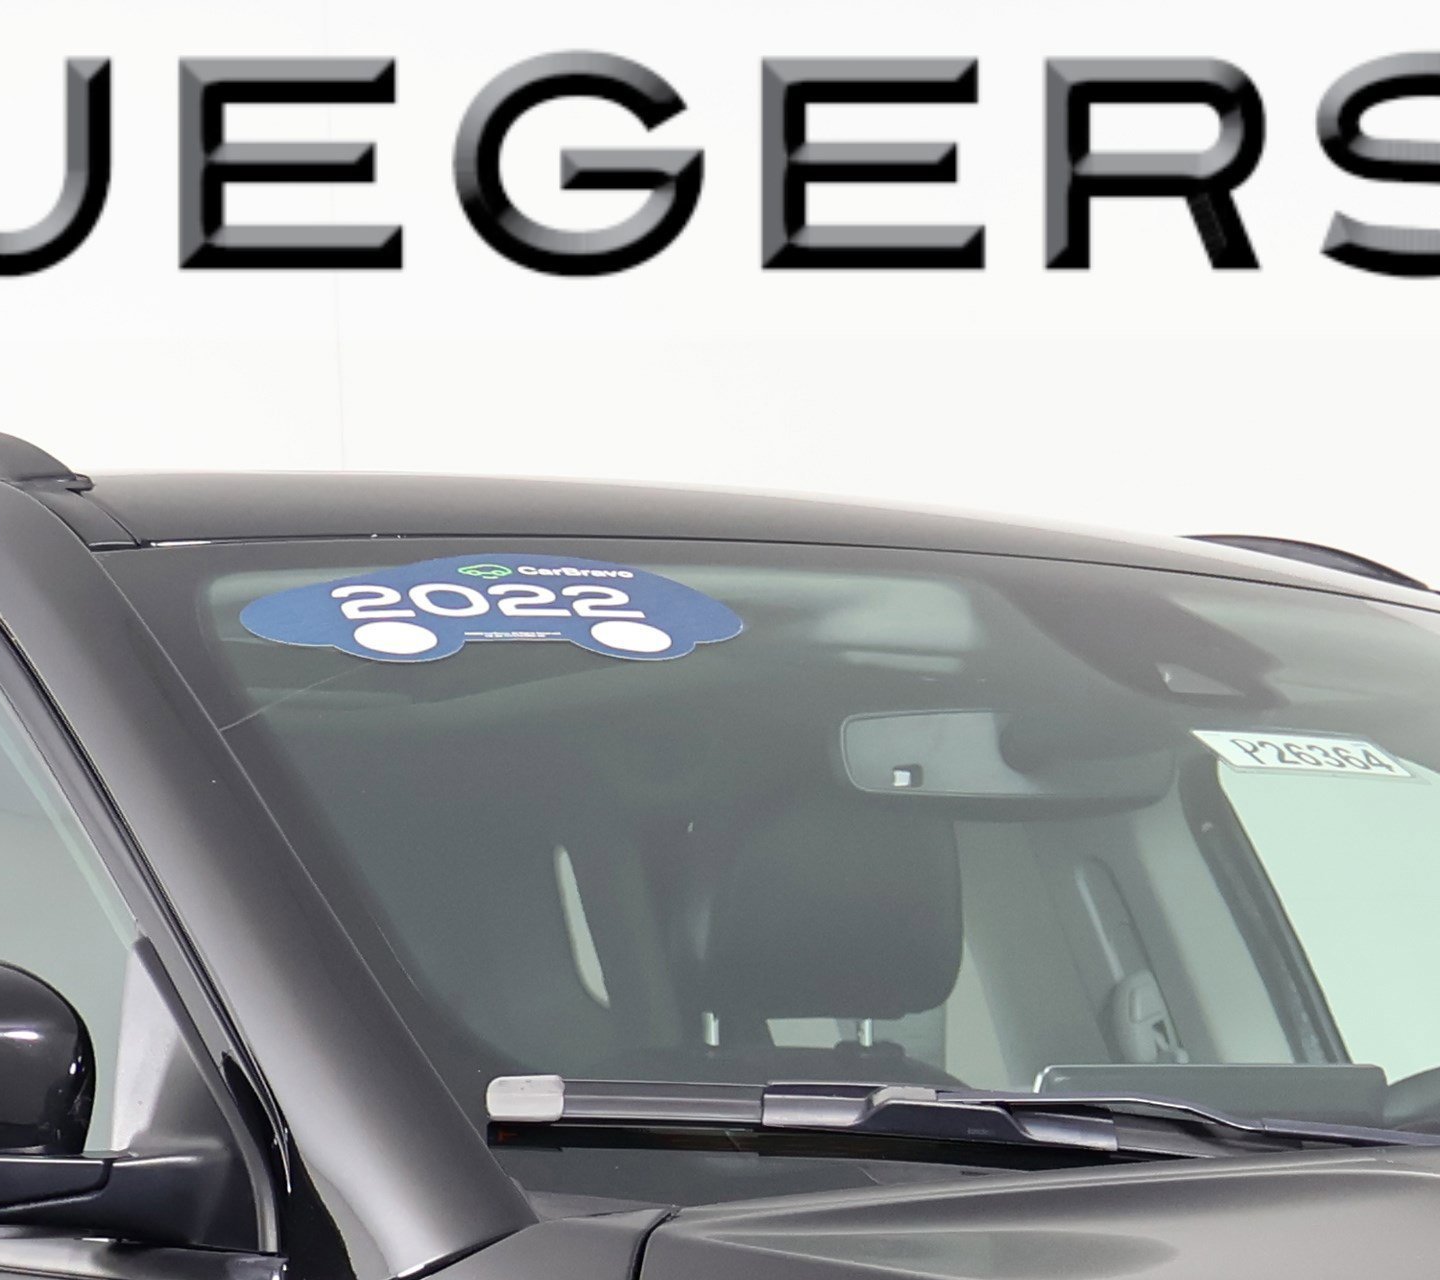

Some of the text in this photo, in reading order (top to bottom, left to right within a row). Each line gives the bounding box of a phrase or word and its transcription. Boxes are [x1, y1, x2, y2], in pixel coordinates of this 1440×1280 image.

[517, 565, 634, 579] CarBravo
[330, 583, 646, 619] 2022
[1229, 737, 1394, 772] P26364
